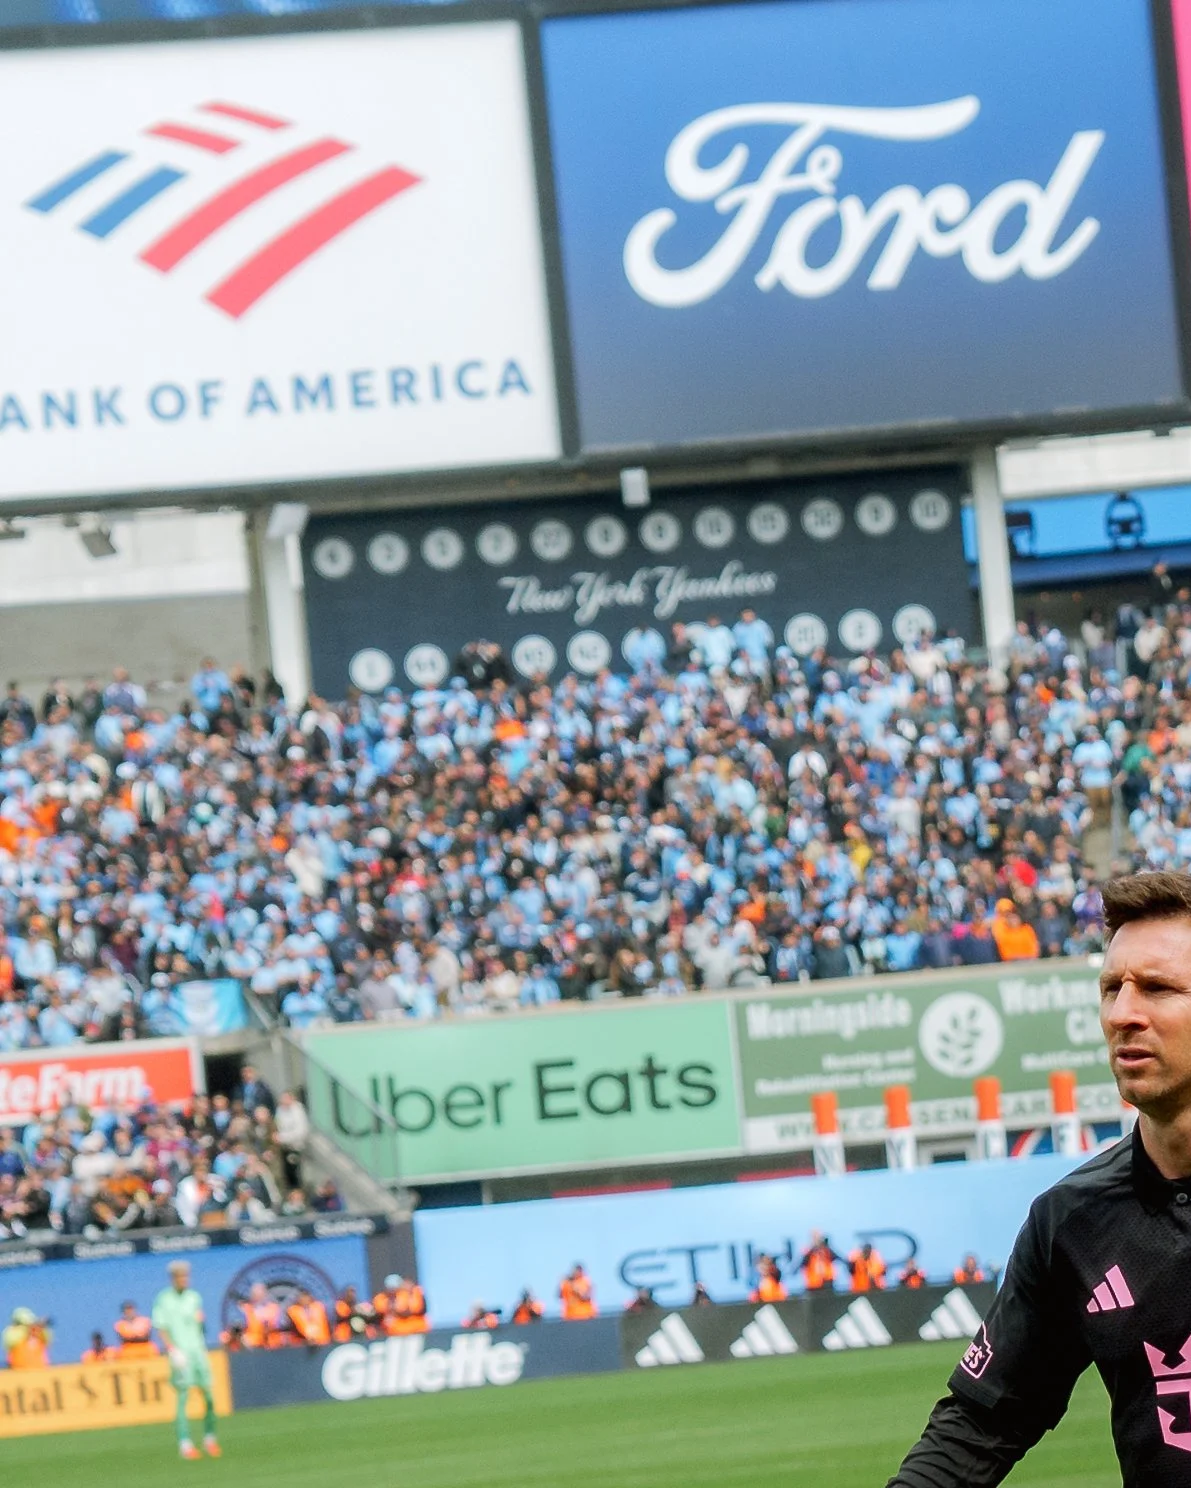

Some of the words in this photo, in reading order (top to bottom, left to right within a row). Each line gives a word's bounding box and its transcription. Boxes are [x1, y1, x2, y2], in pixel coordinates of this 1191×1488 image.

[623, 95, 1105, 308] Ford
[148, 379, 223, 422] OF
[245, 358, 533, 417] AMERICA
[497, 575, 574, 615] New
[570, 566, 651, 626] York
[650, 560, 777, 621] Yankees
[330, 1073, 512, 1138] Uber
[533, 1052, 717, 1122] Eats
[322, 1331, 525, 1400] Gillette
